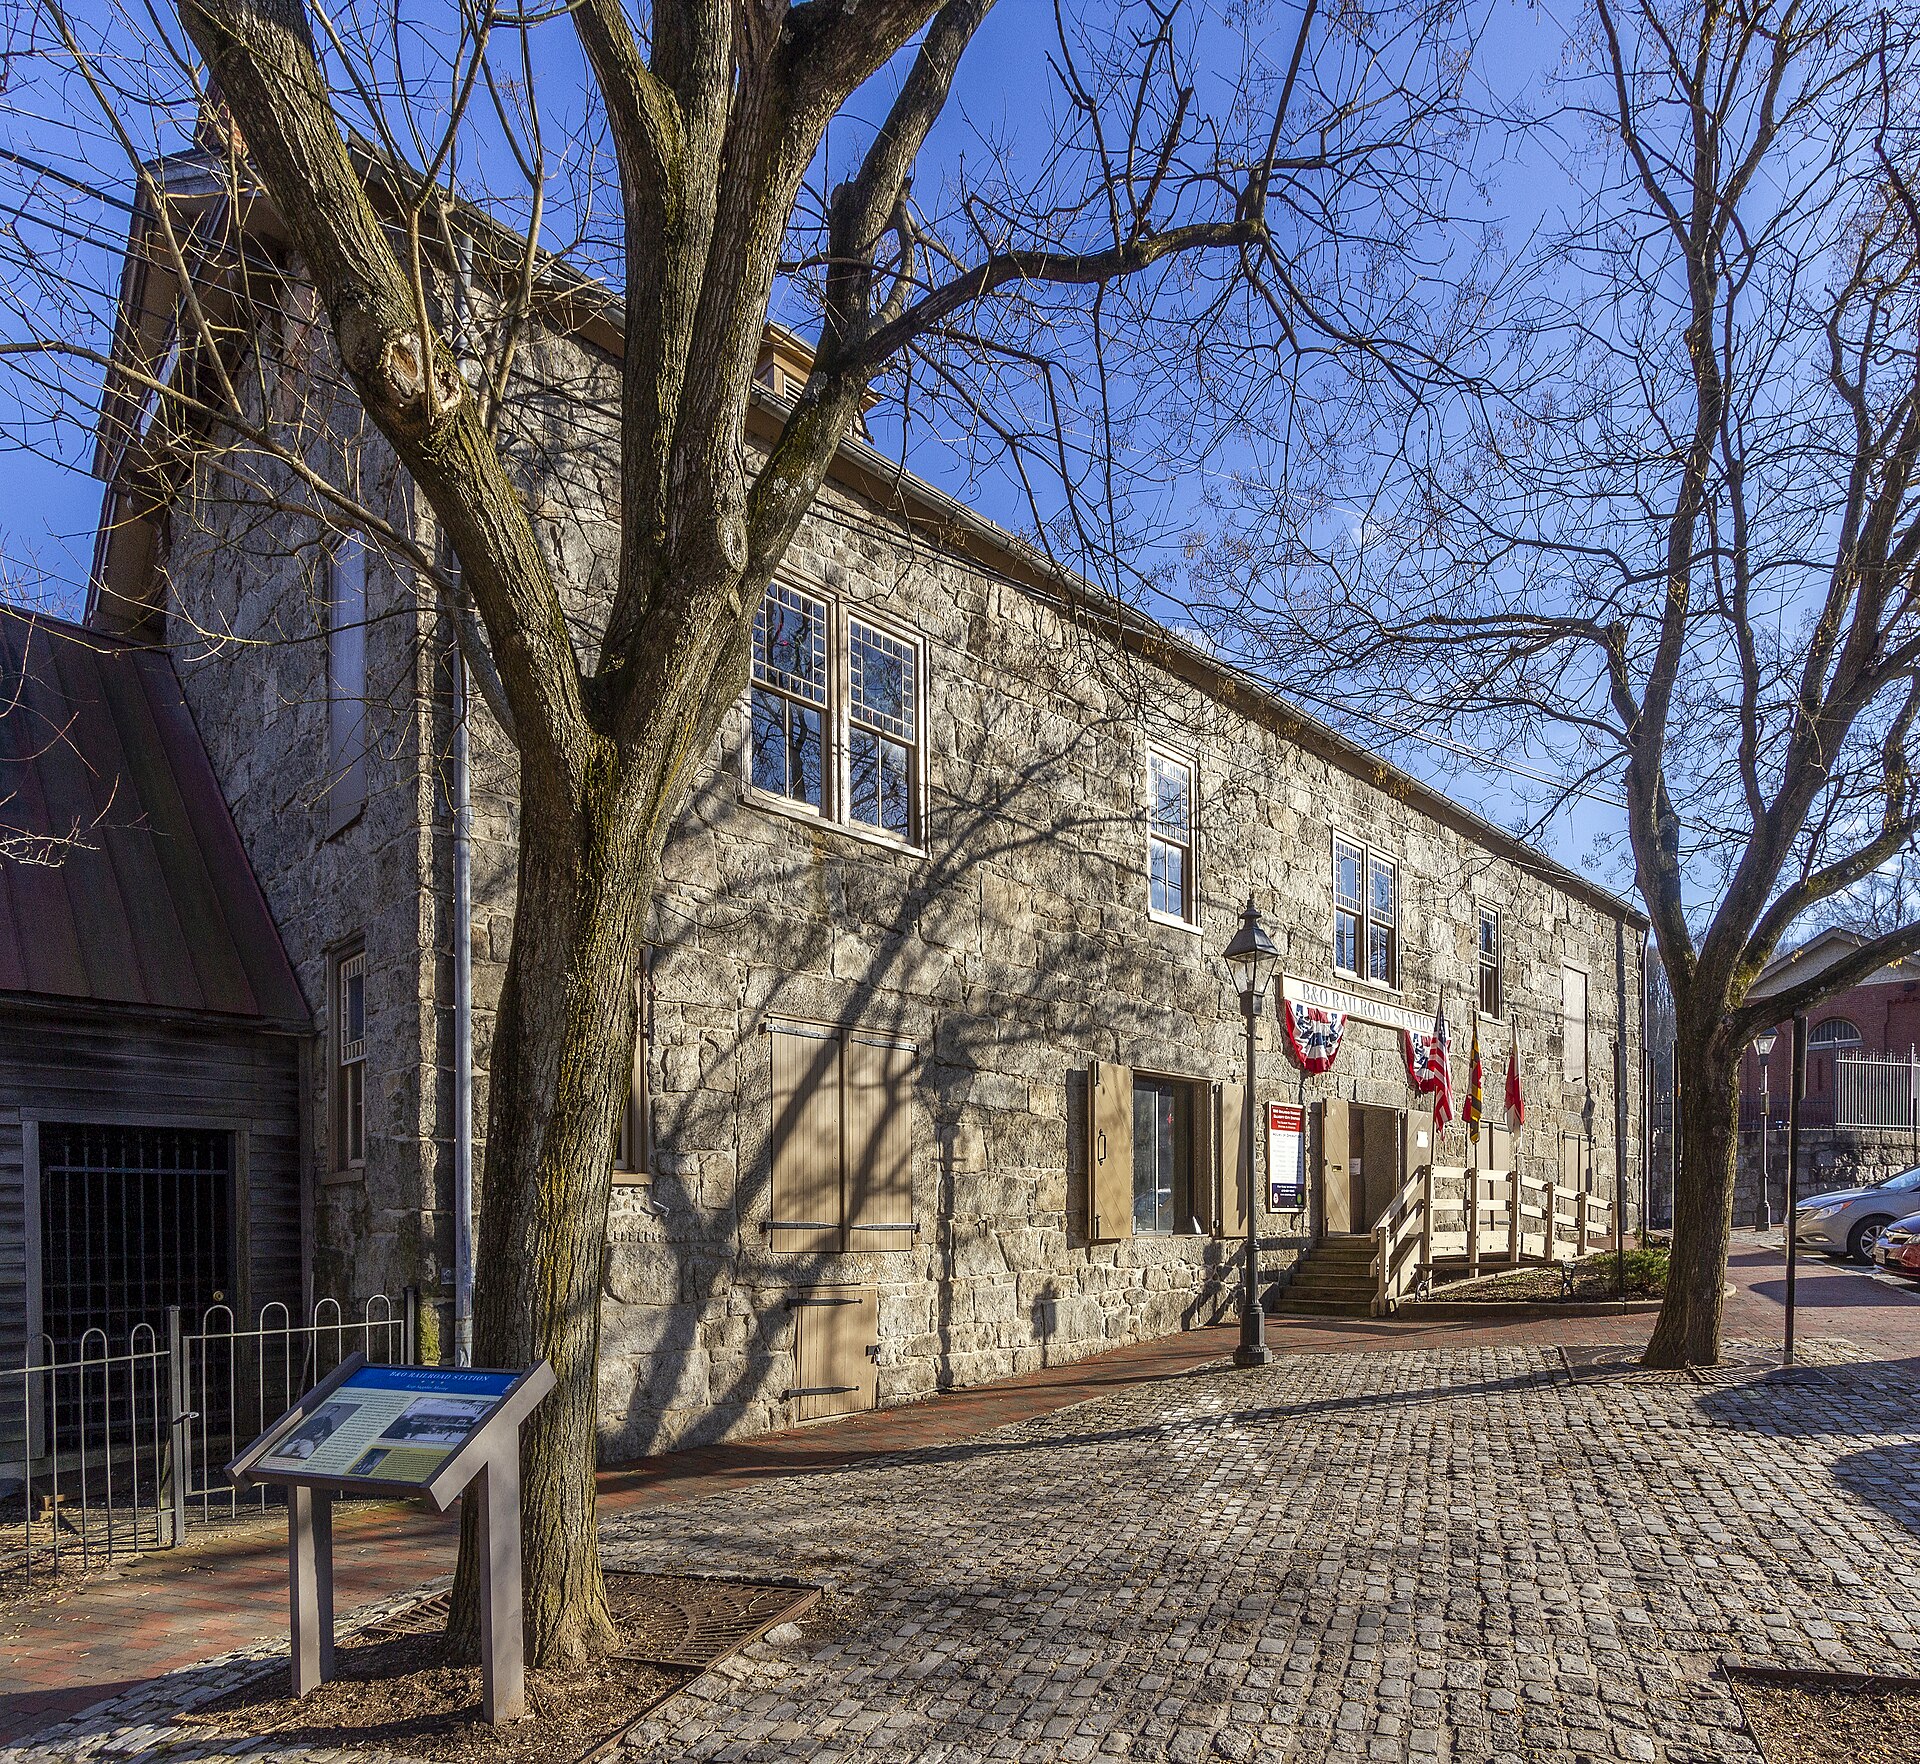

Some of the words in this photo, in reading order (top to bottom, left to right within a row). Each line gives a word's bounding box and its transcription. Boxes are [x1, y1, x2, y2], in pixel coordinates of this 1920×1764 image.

[1302, 983, 1328, 1005] B&O
[1332, 991, 1391, 1021] RAILROAD
[1394, 1009, 1435, 1032] STATION
[408, 1372, 451, 1380] RAILROAD
